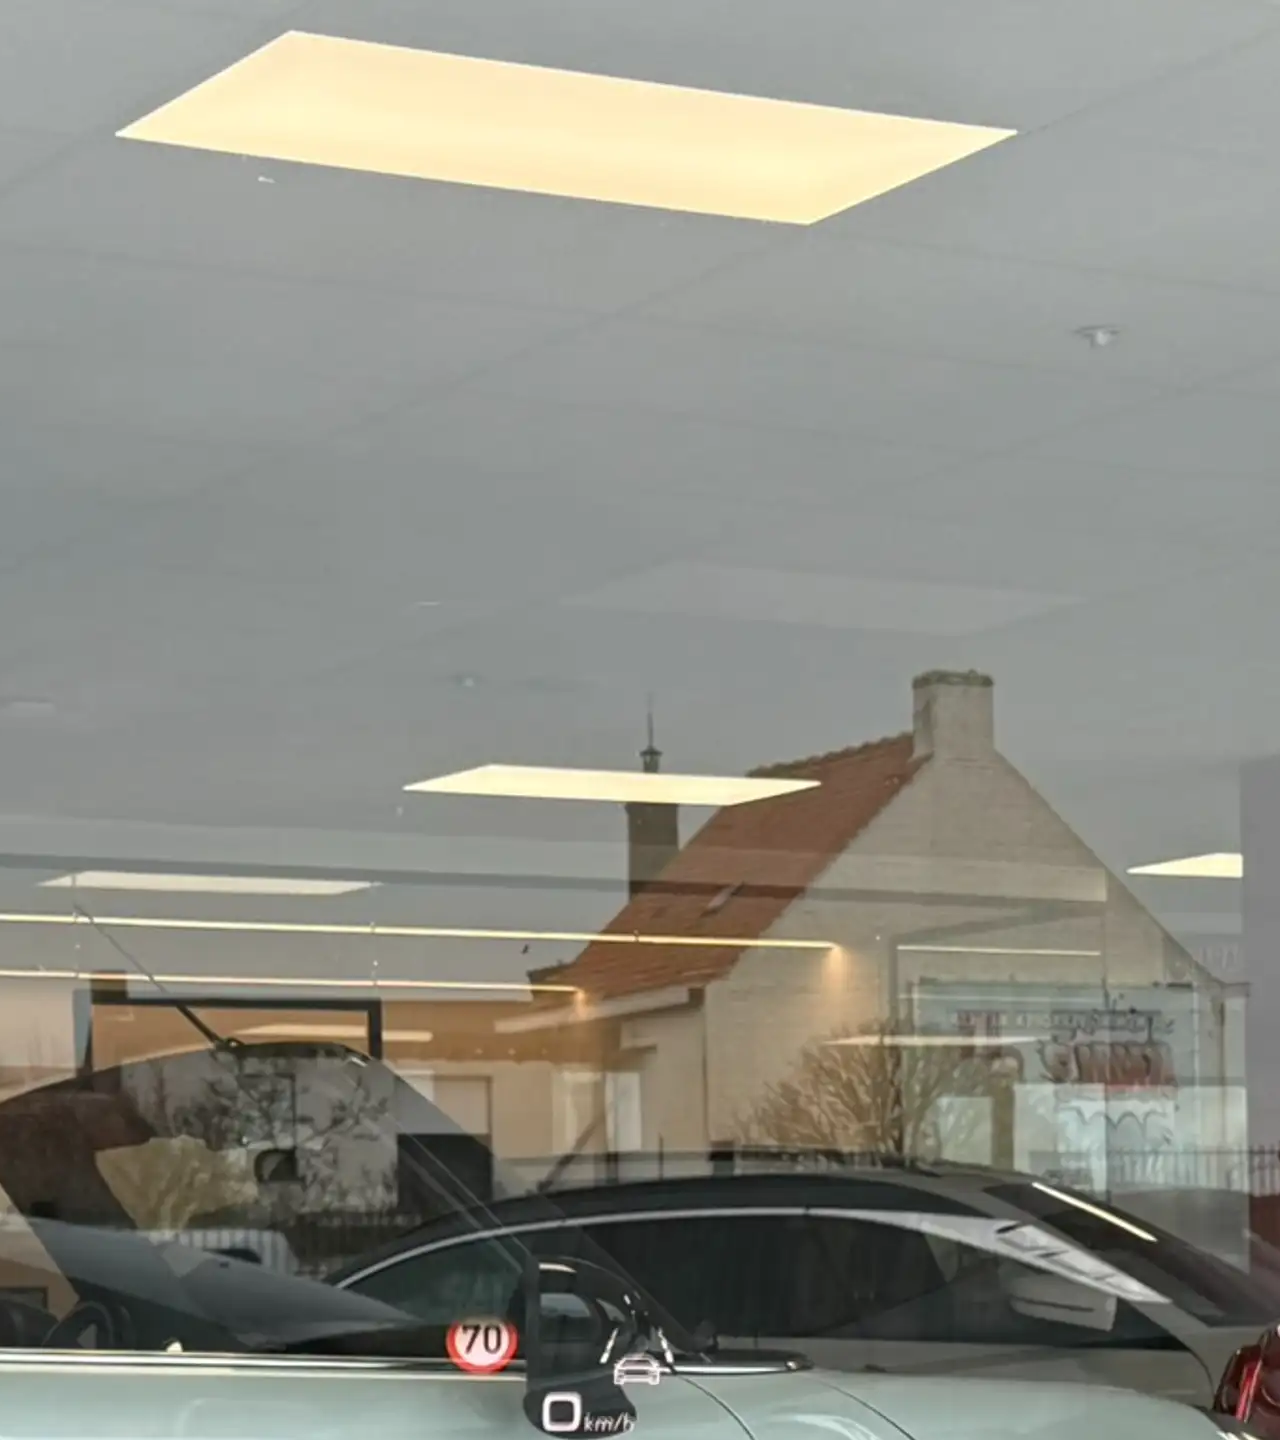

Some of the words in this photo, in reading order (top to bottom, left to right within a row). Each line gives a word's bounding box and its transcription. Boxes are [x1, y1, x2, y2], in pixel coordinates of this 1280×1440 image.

[462, 1323, 502, 1355] 70
[542, 1391, 582, 1432] 0
[583, 1411, 636, 1433] km/h
